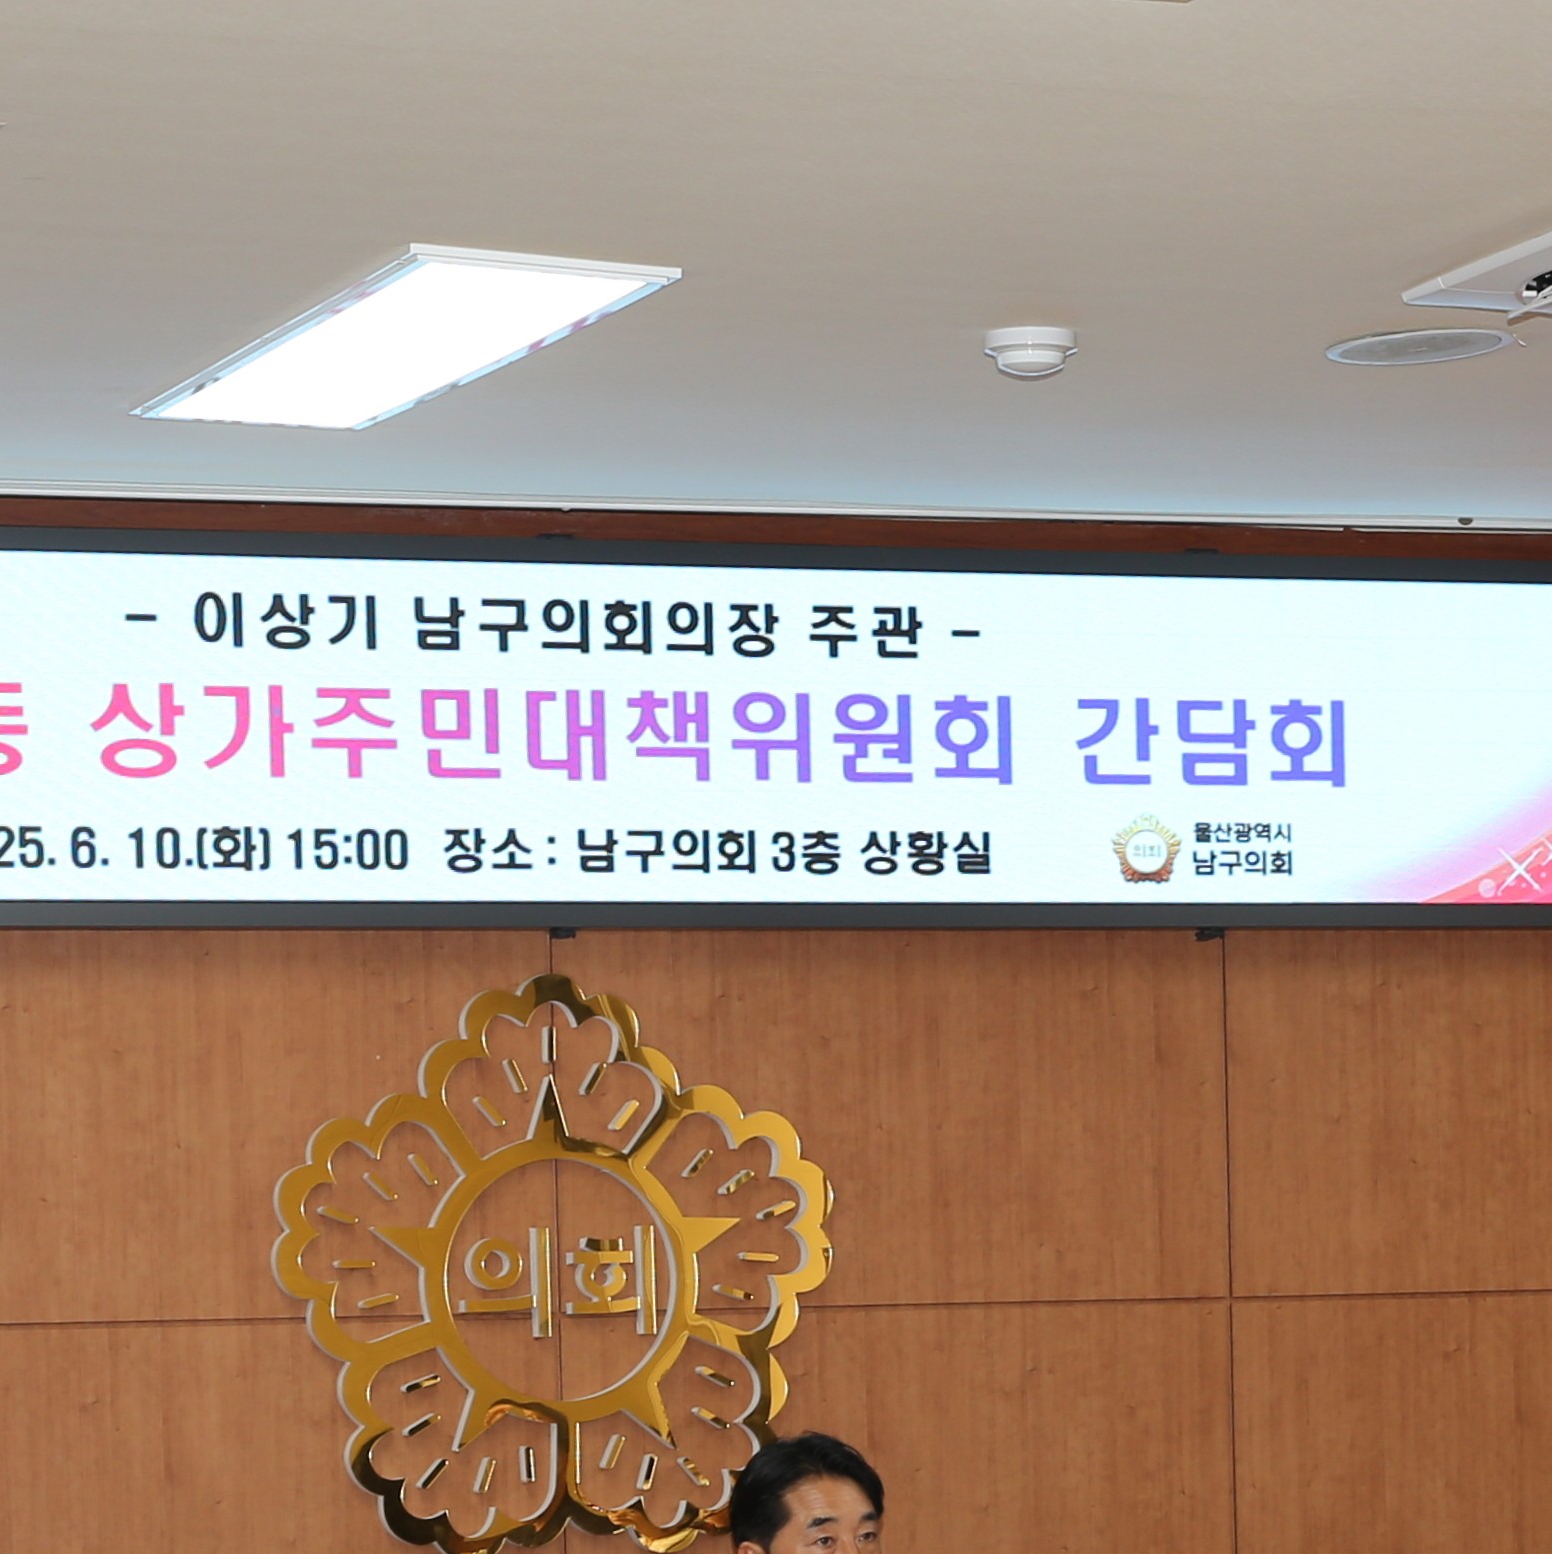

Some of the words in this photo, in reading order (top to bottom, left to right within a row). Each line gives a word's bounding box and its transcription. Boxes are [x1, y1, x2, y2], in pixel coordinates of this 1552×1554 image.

[194, 591, 378, 650] 이상기
[413, 595, 780, 658] 남구의회의장
[808, 604, 923, 659] 주관
[90, 681, 1014, 786] 상가주민대책위원회
[1075, 696, 1347, 788] 간담회
[287, 828, 409, 871] 15:00
[577, 828, 757, 874] 남구의회
[772, 830, 842, 876] 3층
[860, 830, 992, 876] 상황실
[1193, 822, 1292, 844] 울산광역시
[1192, 850, 1293, 876] 남구의회
[458, 1224, 658, 1338] 의회
